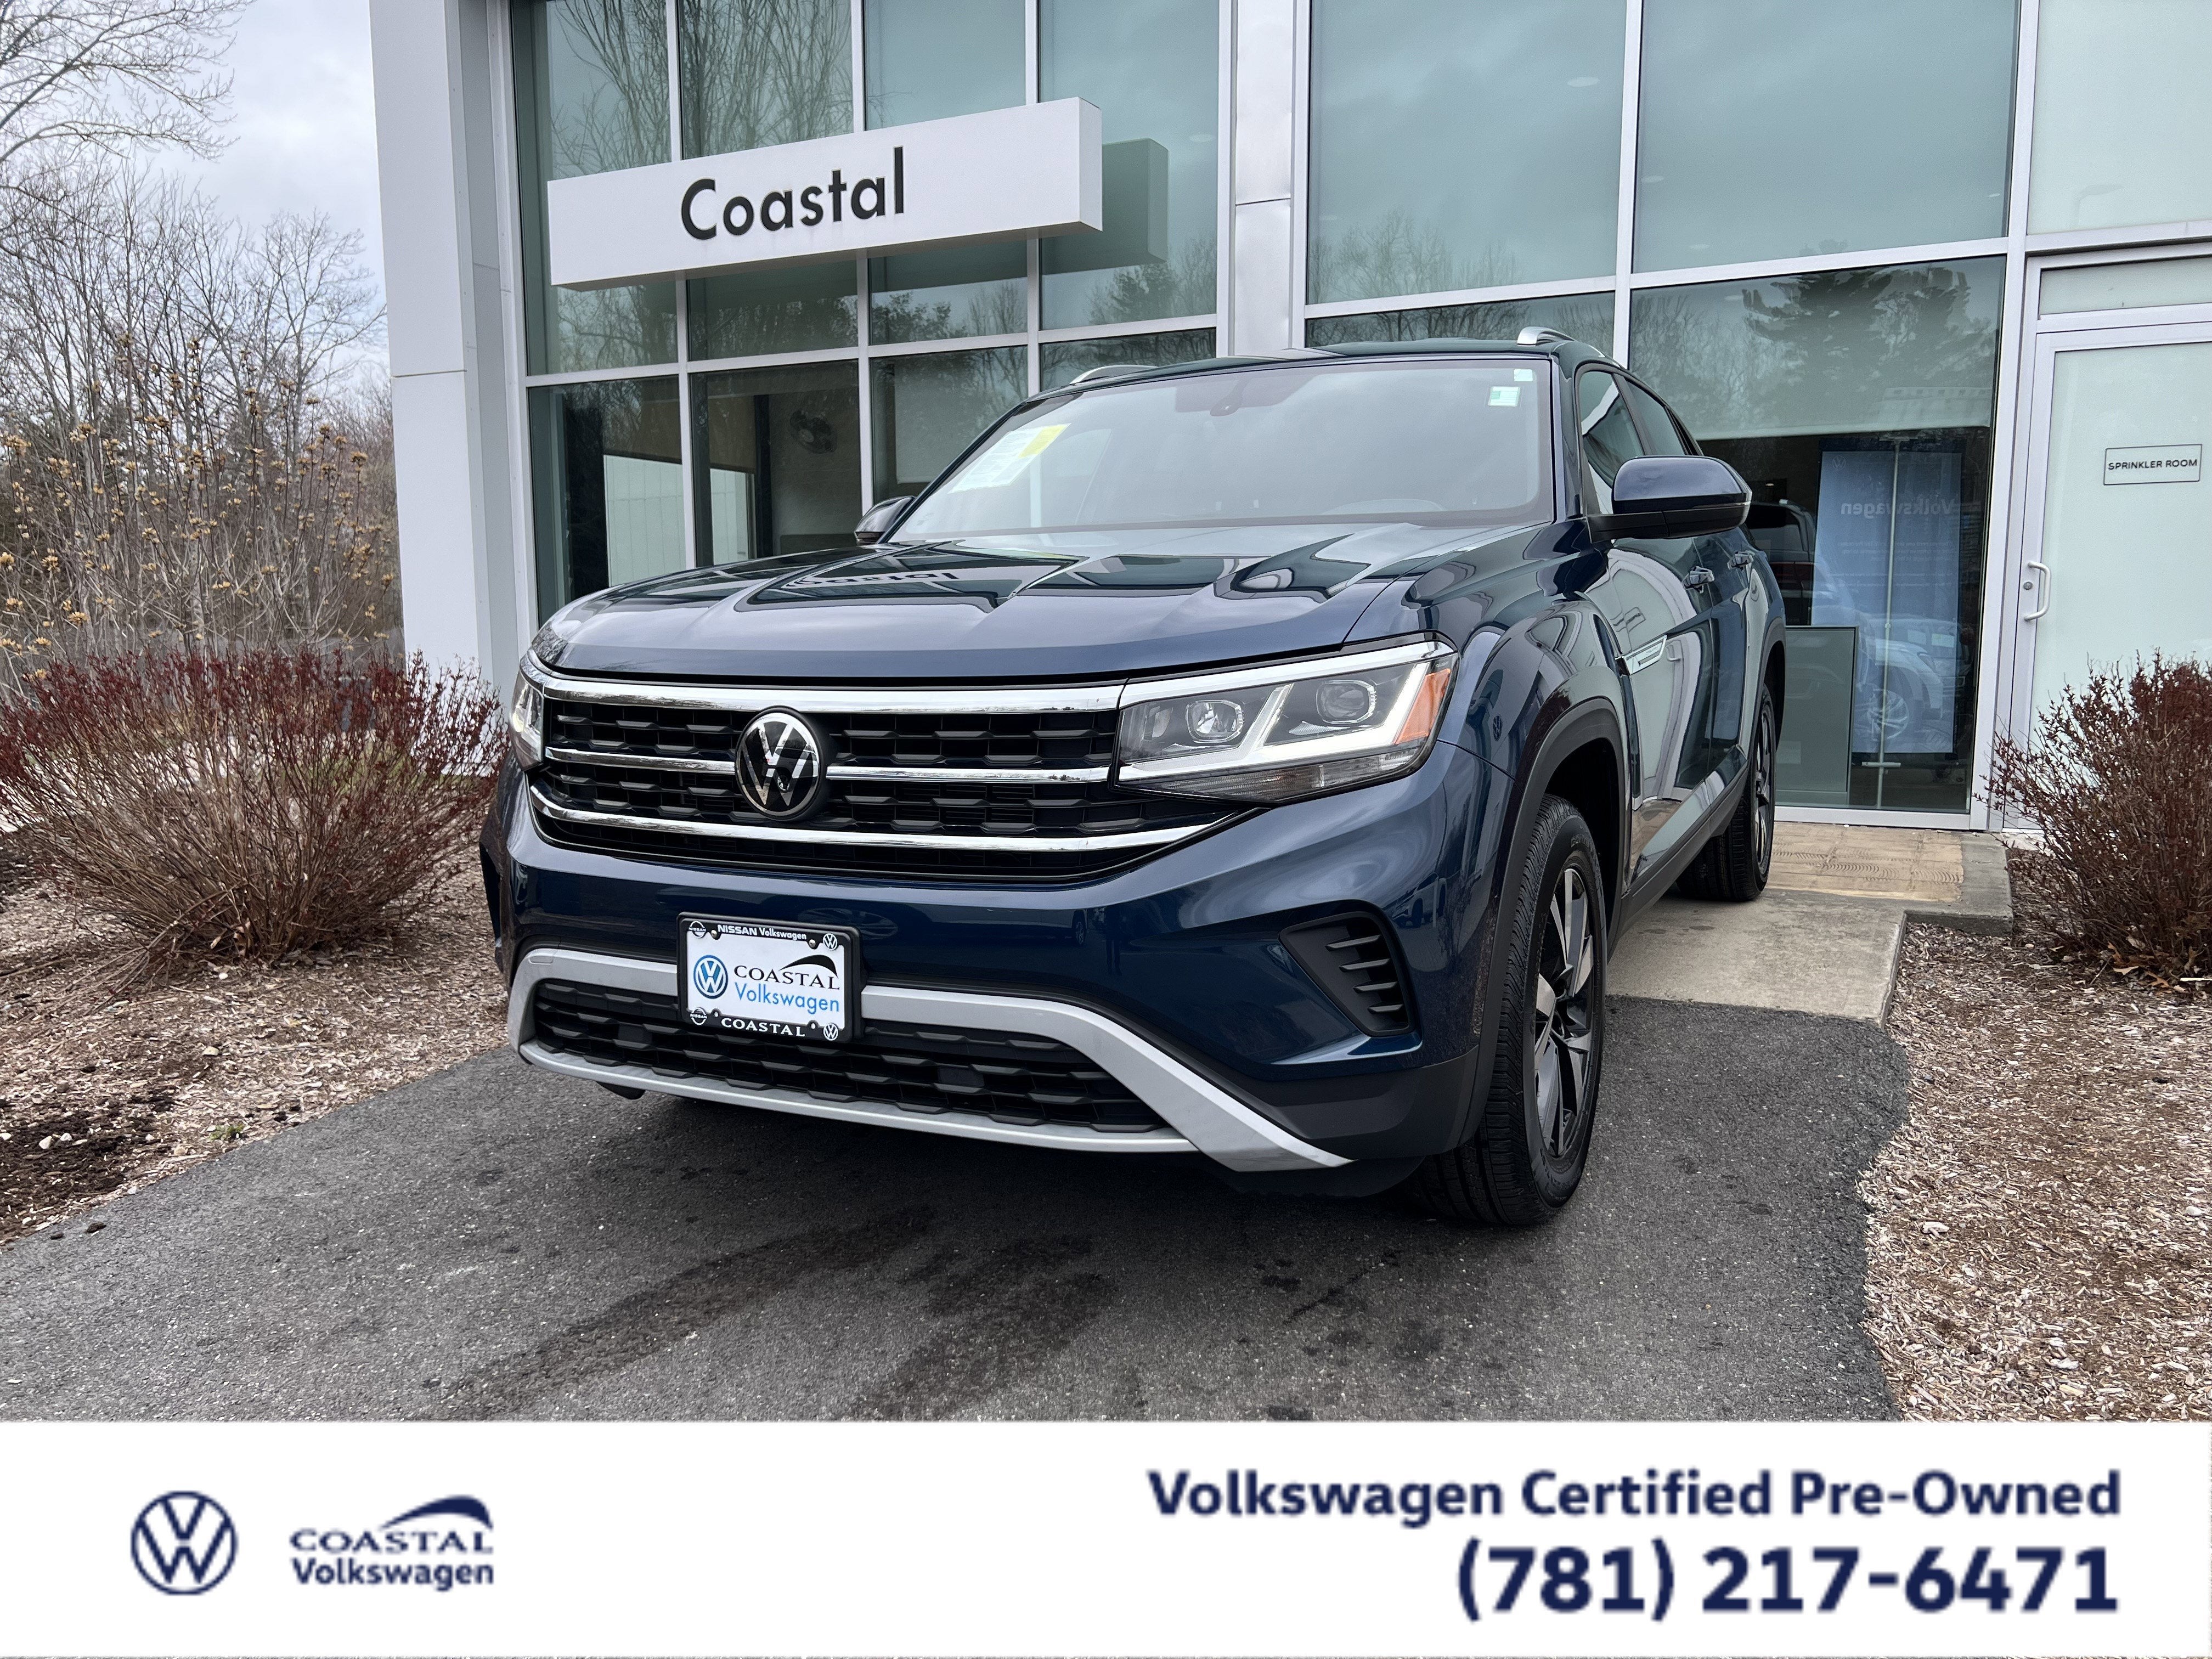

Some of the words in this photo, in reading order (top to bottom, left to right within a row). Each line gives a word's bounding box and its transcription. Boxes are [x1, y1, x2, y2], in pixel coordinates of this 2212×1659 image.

[681, 145, 905, 240] Coastal
[2108, 460, 2163, 470] SPRINKLER
[2165, 459, 2198, 467] ROOM
[717, 924, 758, 936] NISSAN
[759, 927, 807, 940] Volkswagen
[733, 965, 840, 990] COASTAL
[734, 981, 839, 1015] Volkswagen
[721, 1018, 805, 1037] COASTAL
